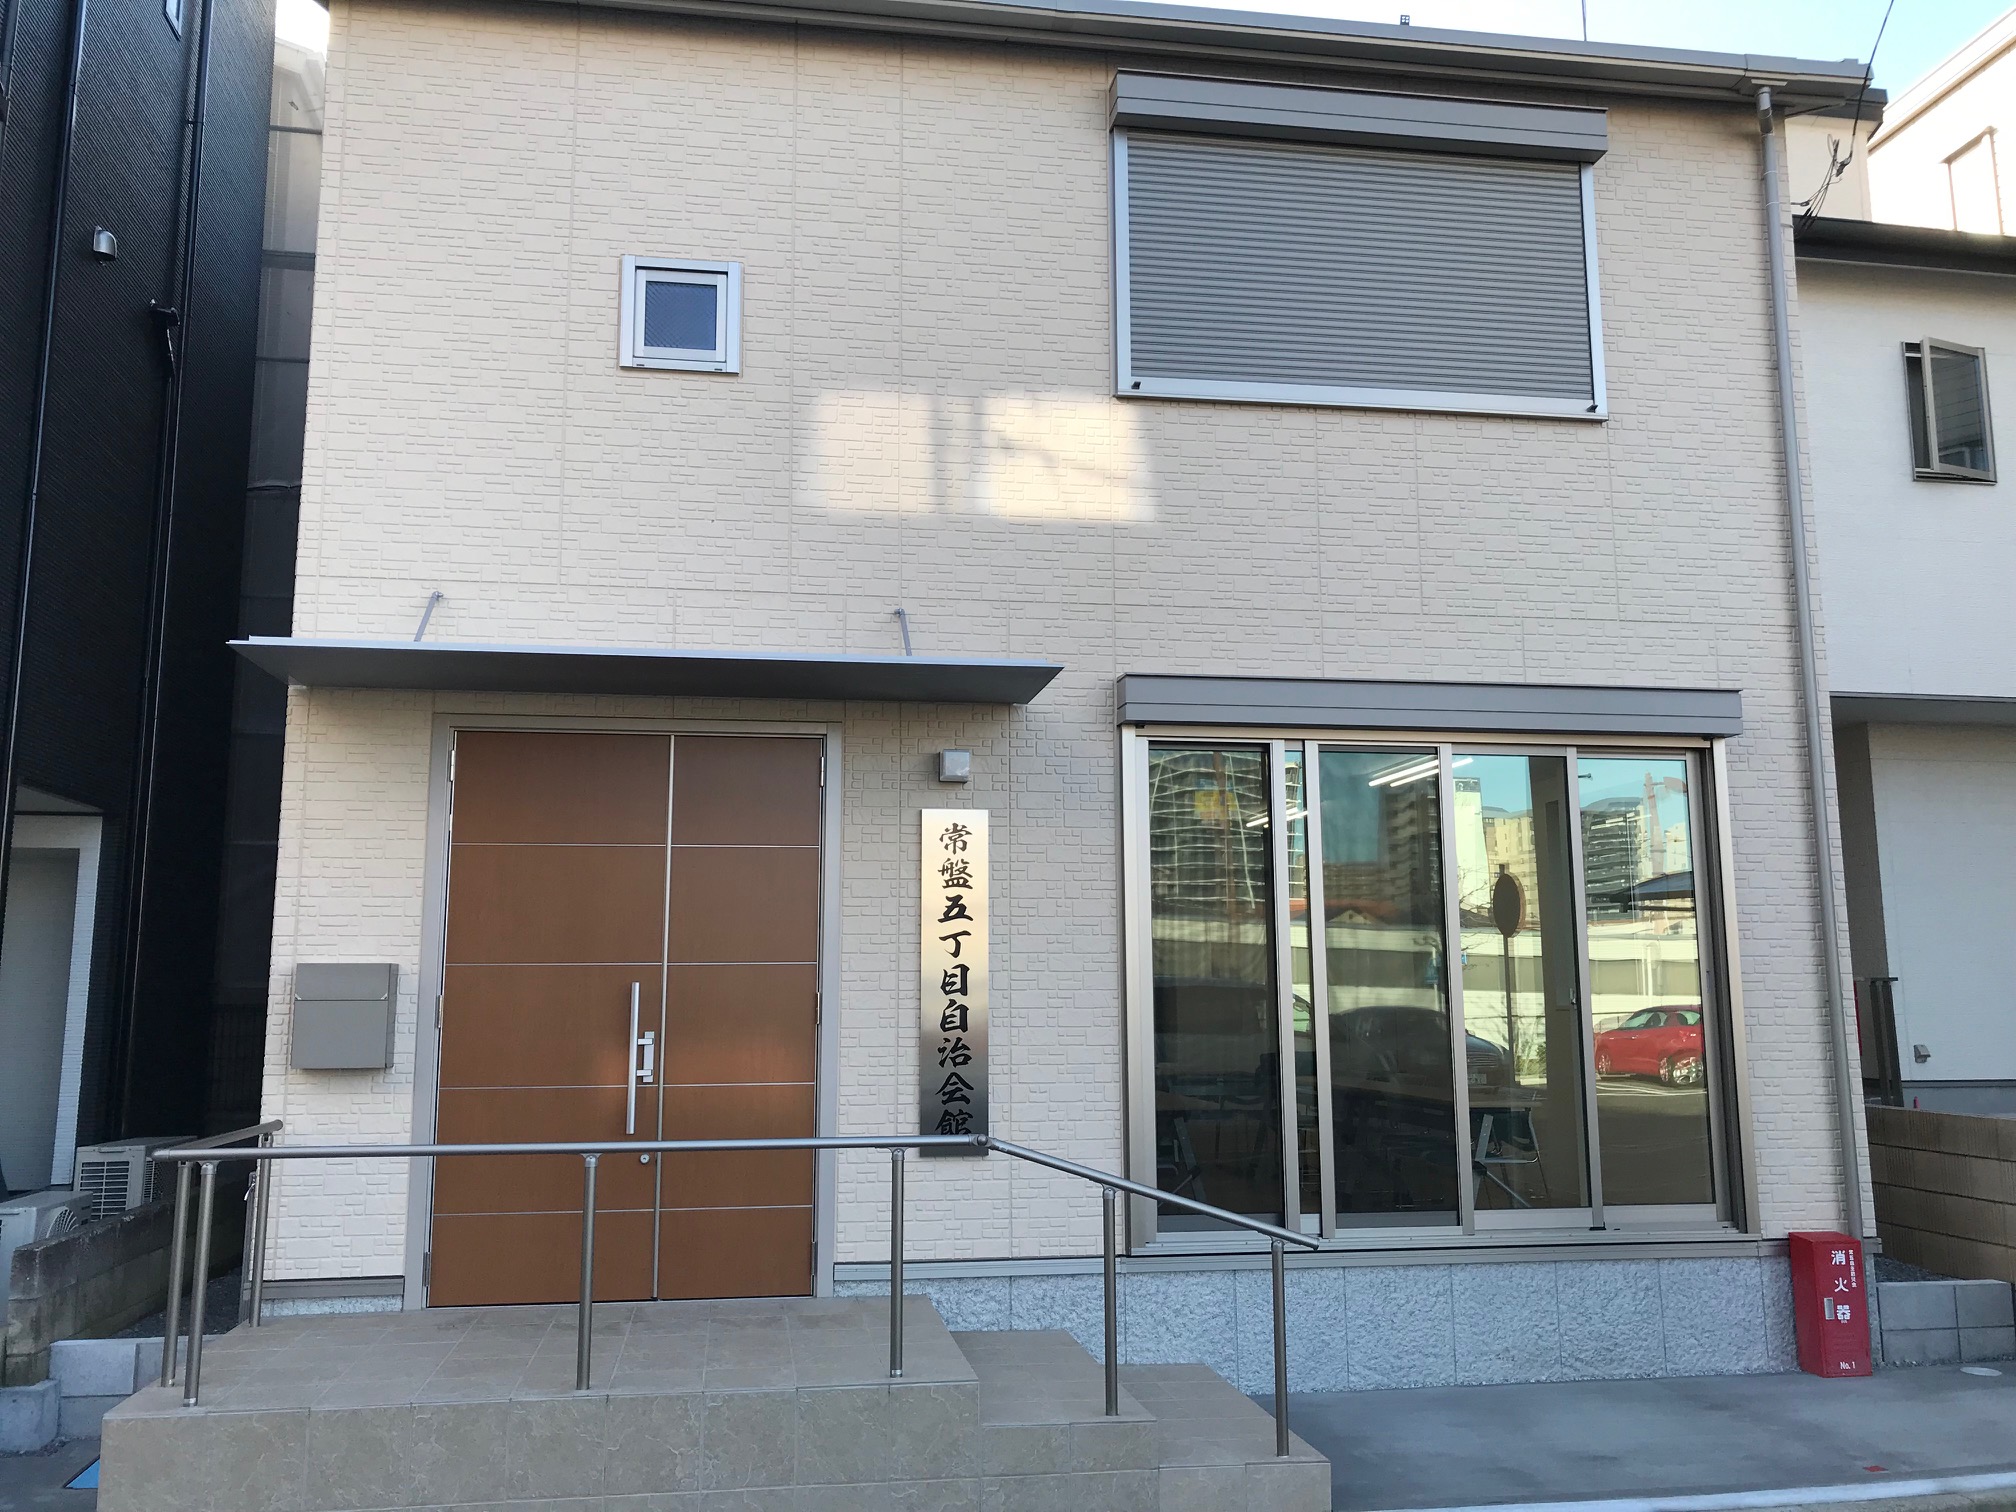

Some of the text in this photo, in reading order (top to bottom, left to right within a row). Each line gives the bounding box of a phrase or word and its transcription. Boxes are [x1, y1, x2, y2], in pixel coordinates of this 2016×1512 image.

[935, 822, 974, 1135] 常盤五丁目自治会館
[1831, 1250, 1851, 1320] 消火器
